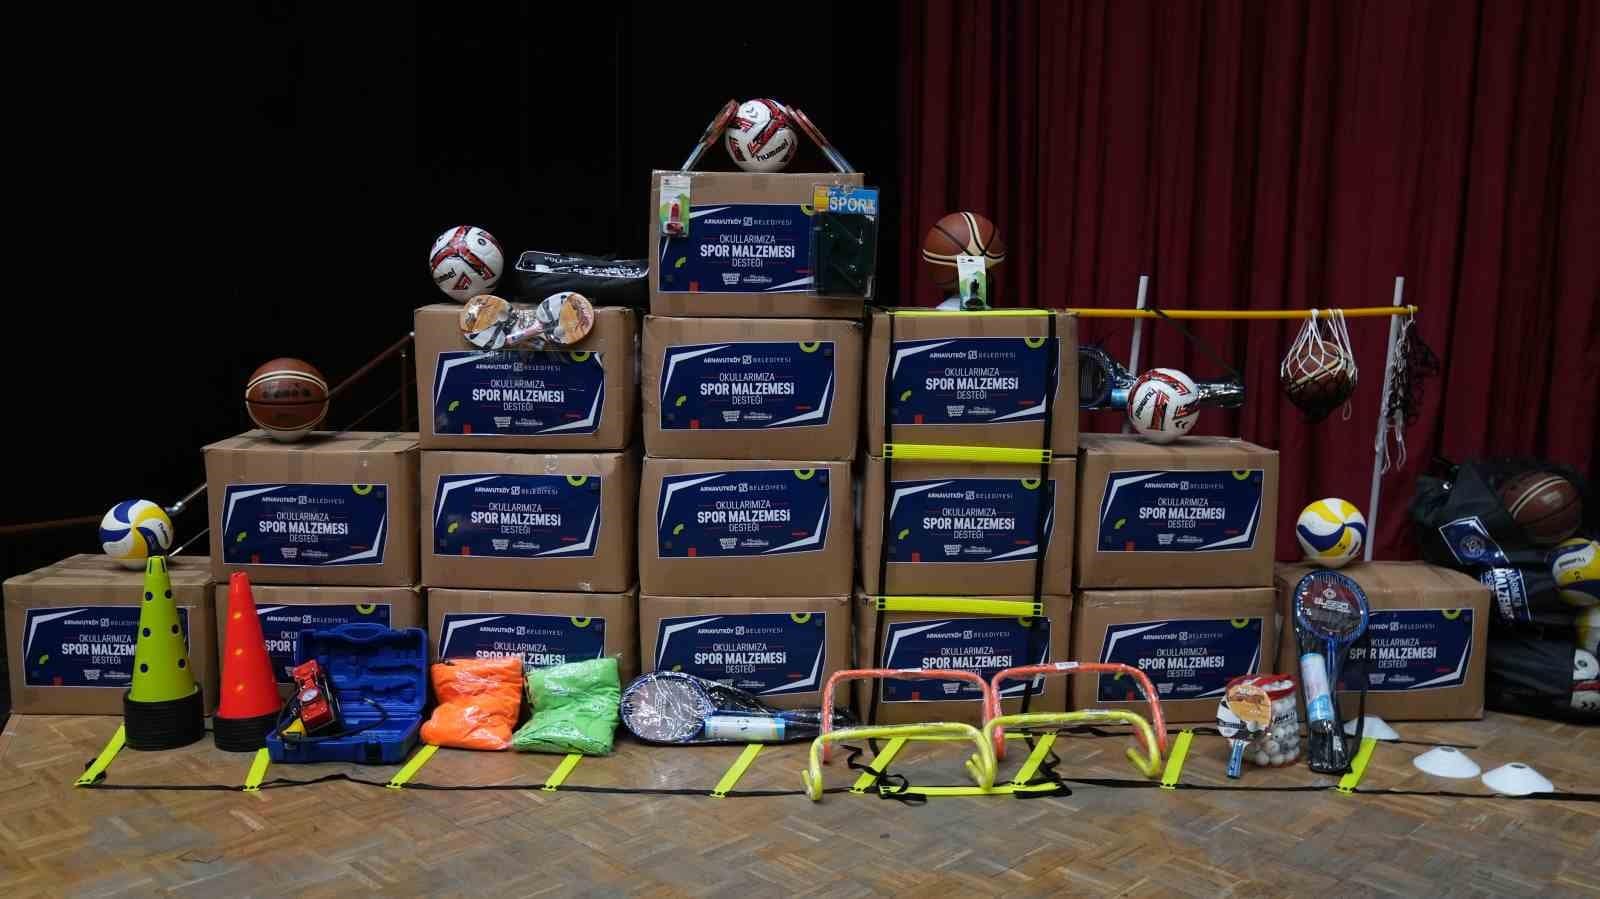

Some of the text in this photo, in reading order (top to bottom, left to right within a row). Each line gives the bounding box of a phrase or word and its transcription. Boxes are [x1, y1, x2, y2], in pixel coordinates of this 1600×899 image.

[720, 234, 775, 243] OKULLARIMIZA
[700, 245, 795, 257] SPOR MALZEMESİ
[945, 368, 999, 376] OKULLARIMIZA
[719, 373, 775, 381] OKULLARIMIZA
[490, 380, 545, 388] OKULLARIMIZA
[926, 378, 1018, 390] SPOR MALZEMESİ
[700, 383, 794, 395] SPOR MALZEMESİ
[472, 389, 564, 402] SPOR MALZEMESİ
[716, 500, 770, 509] OKULLARIMIZA
[1158, 498, 1208, 506] OKULLARIMIZA
[489, 503, 542, 512] OKULLARIMIZA
[942, 508, 996, 516] OKULLARIMIZA
[276, 512, 329, 521] OKULLARIMIZA
[697, 510, 790, 523] SPOR MALZEMESİ
[1139, 507, 1225, 519] SPOR MALZEMESİ
[471, 512, 561, 526] SPOR MALZEMESİ
[259, 521, 348, 534] SPOR MALZEMESİ
[923, 518, 1015, 530] SPOR MALZEMESİ
[79, 635, 131, 643] OKULLARIMIZA
[1371, 639, 1419, 647] KULLARIMIZA
[62, 644, 136, 655] SPOR MALZEM
[494, 642, 546, 651] OKULLARIMIZA
[713, 643, 767, 652] OKULLARIMIZA
[941, 647, 994, 655] OKULLARIMIZA
[1157, 648, 1207, 656] OKULLARIMIZA
[1379, 647, 1436, 658] MALZEMESİ
[695, 652, 786, 664] SPOR MALZEMESİ
[922, 656, 1012, 669] SPOR MALZEMESİ
[1138, 656, 1224, 669] SPOR MALZEMESİ
